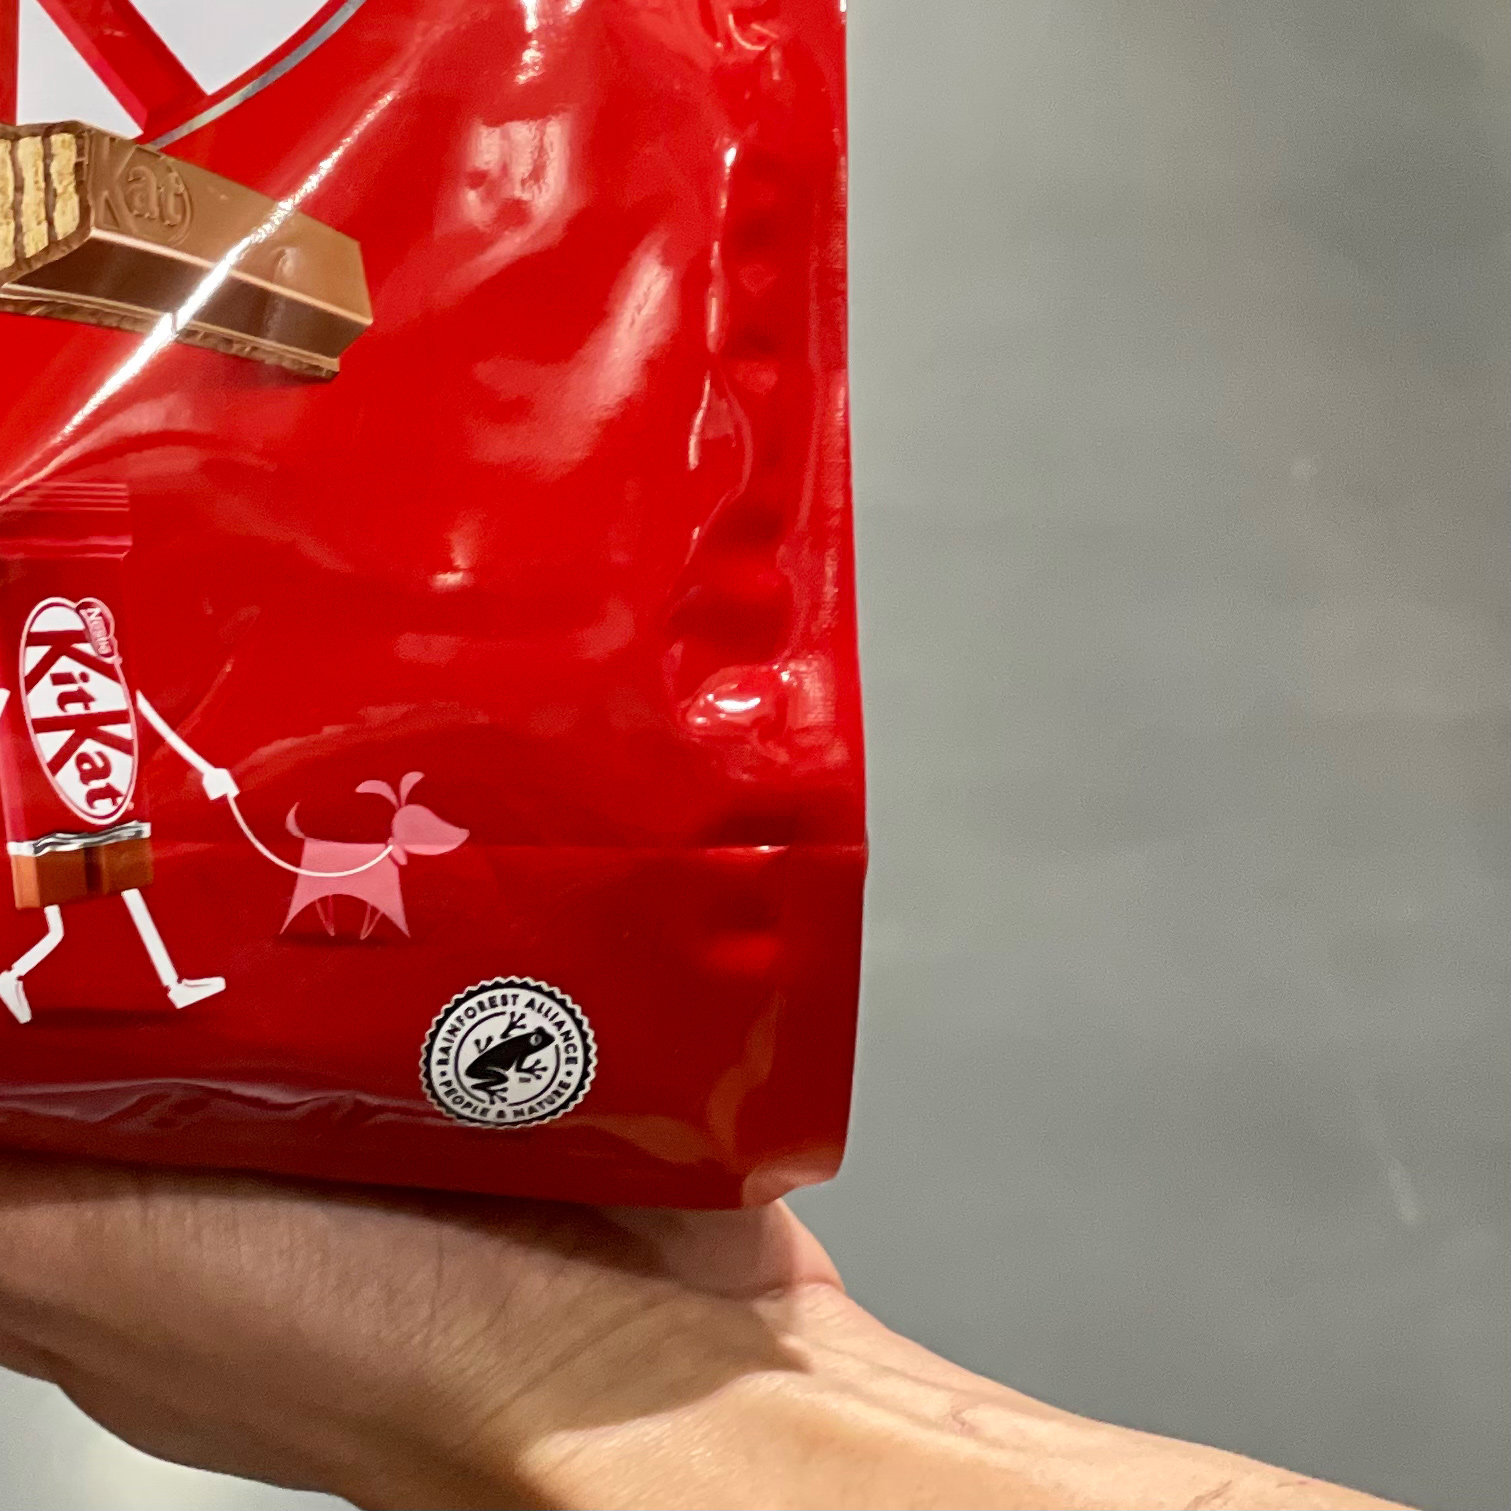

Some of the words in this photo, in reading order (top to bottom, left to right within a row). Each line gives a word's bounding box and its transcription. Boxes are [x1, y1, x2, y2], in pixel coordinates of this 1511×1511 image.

[24, 629, 135, 810] KitKat
[436, 994, 520, 1066] RAINFOREST
[525, 997, 579, 1066] ALLIANCE
[439, 1079, 490, 1118] PEOPLE
[512, 1079, 572, 1119] NATURE
